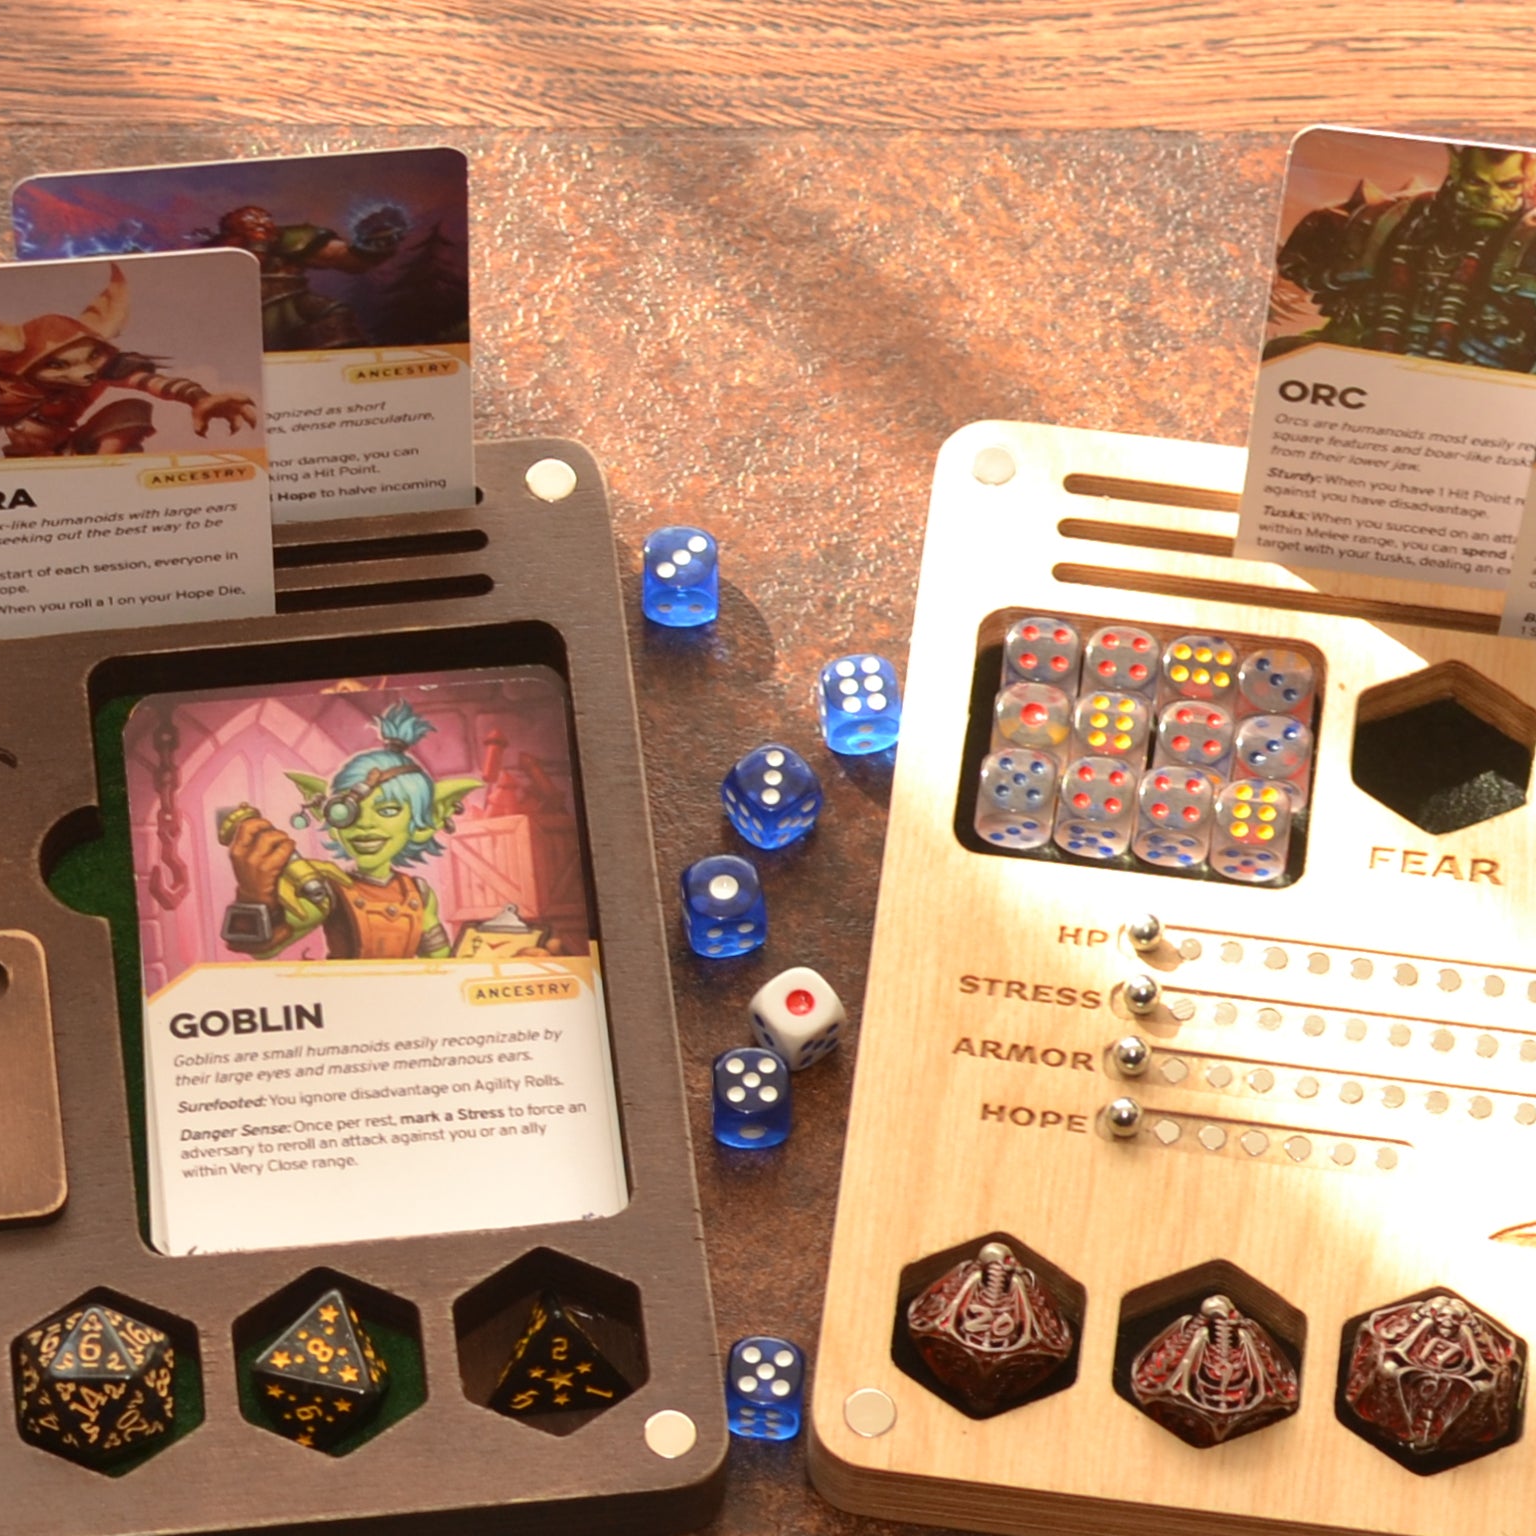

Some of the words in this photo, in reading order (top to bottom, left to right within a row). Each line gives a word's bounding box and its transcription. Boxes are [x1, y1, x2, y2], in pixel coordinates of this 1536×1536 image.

[356, 363, 450, 379] ANCESTRY
[1277, 379, 1368, 410] ORC
[290, 420, 337, 432] dense
[362, 450, 390, 462] you
[392, 447, 419, 457] can
[151, 468, 246, 484] ANCESTRY
[301, 471, 311, 480] a
[314, 467, 335, 478] Hit
[277, 491, 317, 502] Hope
[319, 488, 335, 498] to
[338, 485, 377, 496] halve
[380, 479, 447, 492] incoming
[1263, 484, 1317, 498] against
[1320, 492, 1348, 503] you
[1350, 493, 1387, 507] have
[36, 565, 52, 577] of
[54, 564, 90, 576] each
[93, 560, 151, 573] session,
[153, 553, 222, 567] everyone
[225, 551, 239, 560] in
[39, 602, 66, 613] you
[69, 597, 92, 609] roll
[95, 598, 104, 607] a
[108, 595, 113, 606] 1
[116, 596, 136, 606] on
[139, 592, 171, 605] your
[175, 589, 215, 600] Hope
[218, 585, 246, 596] Die,
[1369, 846, 1504, 887] FEAR
[1058, 925, 1109, 947] HP
[475, 983, 570, 999] ANCESTRY
[959, 974, 1101, 1010] STRESS
[169, 1004, 323, 1039] GOBLIN
[173, 1052, 230, 1068] Goblins
[233, 1051, 259, 1063] are
[261, 1045, 303, 1061] small
[305, 1040, 391, 1057] humanoids
[393, 1036, 439, 1051] easily
[441, 1029, 541, 1048] recognizable
[543, 1028, 563, 1042] by
[951, 1037, 1095, 1072] ARMOR
[175, 1073, 212, 1087] their
[214, 1071, 254, 1085] large
[256, 1067, 291, 1082] eyes
[294, 1063, 325, 1078] and
[327, 1060, 390, 1074] massive
[392, 1053, 494, 1070] membranous
[496, 1050, 533, 1063] ears.
[177, 1096, 266, 1114] Surefooted:
[267, 1094, 297, 1106] You
[299, 1091, 347, 1107] ignore
[349, 1084, 449, 1100] disadvantage
[451, 1082, 471, 1093] on
[474, 1077, 521, 1093] Agility
[524, 1074, 564, 1087] Rolls.
[179, 1127, 238, 1142] Danger
[240, 1123, 292, 1137] Sense:
[292, 1119, 333, 1133] Once
[336, 1118, 361, 1132] per
[364, 1114, 397, 1127] rest,
[399, 1110, 441, 1125] mark
[443, 1111, 454, 1122] a
[456, 1107, 505, 1121] Stress
[507, 1105, 524, 1117] to
[526, 1103, 565, 1116] force
[567, 1102, 587, 1114] an
[980, 1103, 1088, 1134] HOPE
[180, 1145, 255, 1160] adversary
[257, 1141, 274, 1154] to
[276, 1137, 316, 1152] reroll
[318, 1138, 338, 1149] an
[340, 1132, 388, 1147] attack
[390, 1128, 445, 1146] against
[448, 1128, 477, 1142] you
[479, 1126, 496, 1138] or
[498, 1125, 518, 1136] an
[520, 1121, 547, 1136] ally
[181, 1164, 228, 1178] within
[229, 1162, 264, 1176] Very
[266, 1158, 309, 1172] Close
[311, 1156, 358, 1169] range.
[307, 1337, 334, 1362] 8
[69, 1386, 108, 1422] 14
